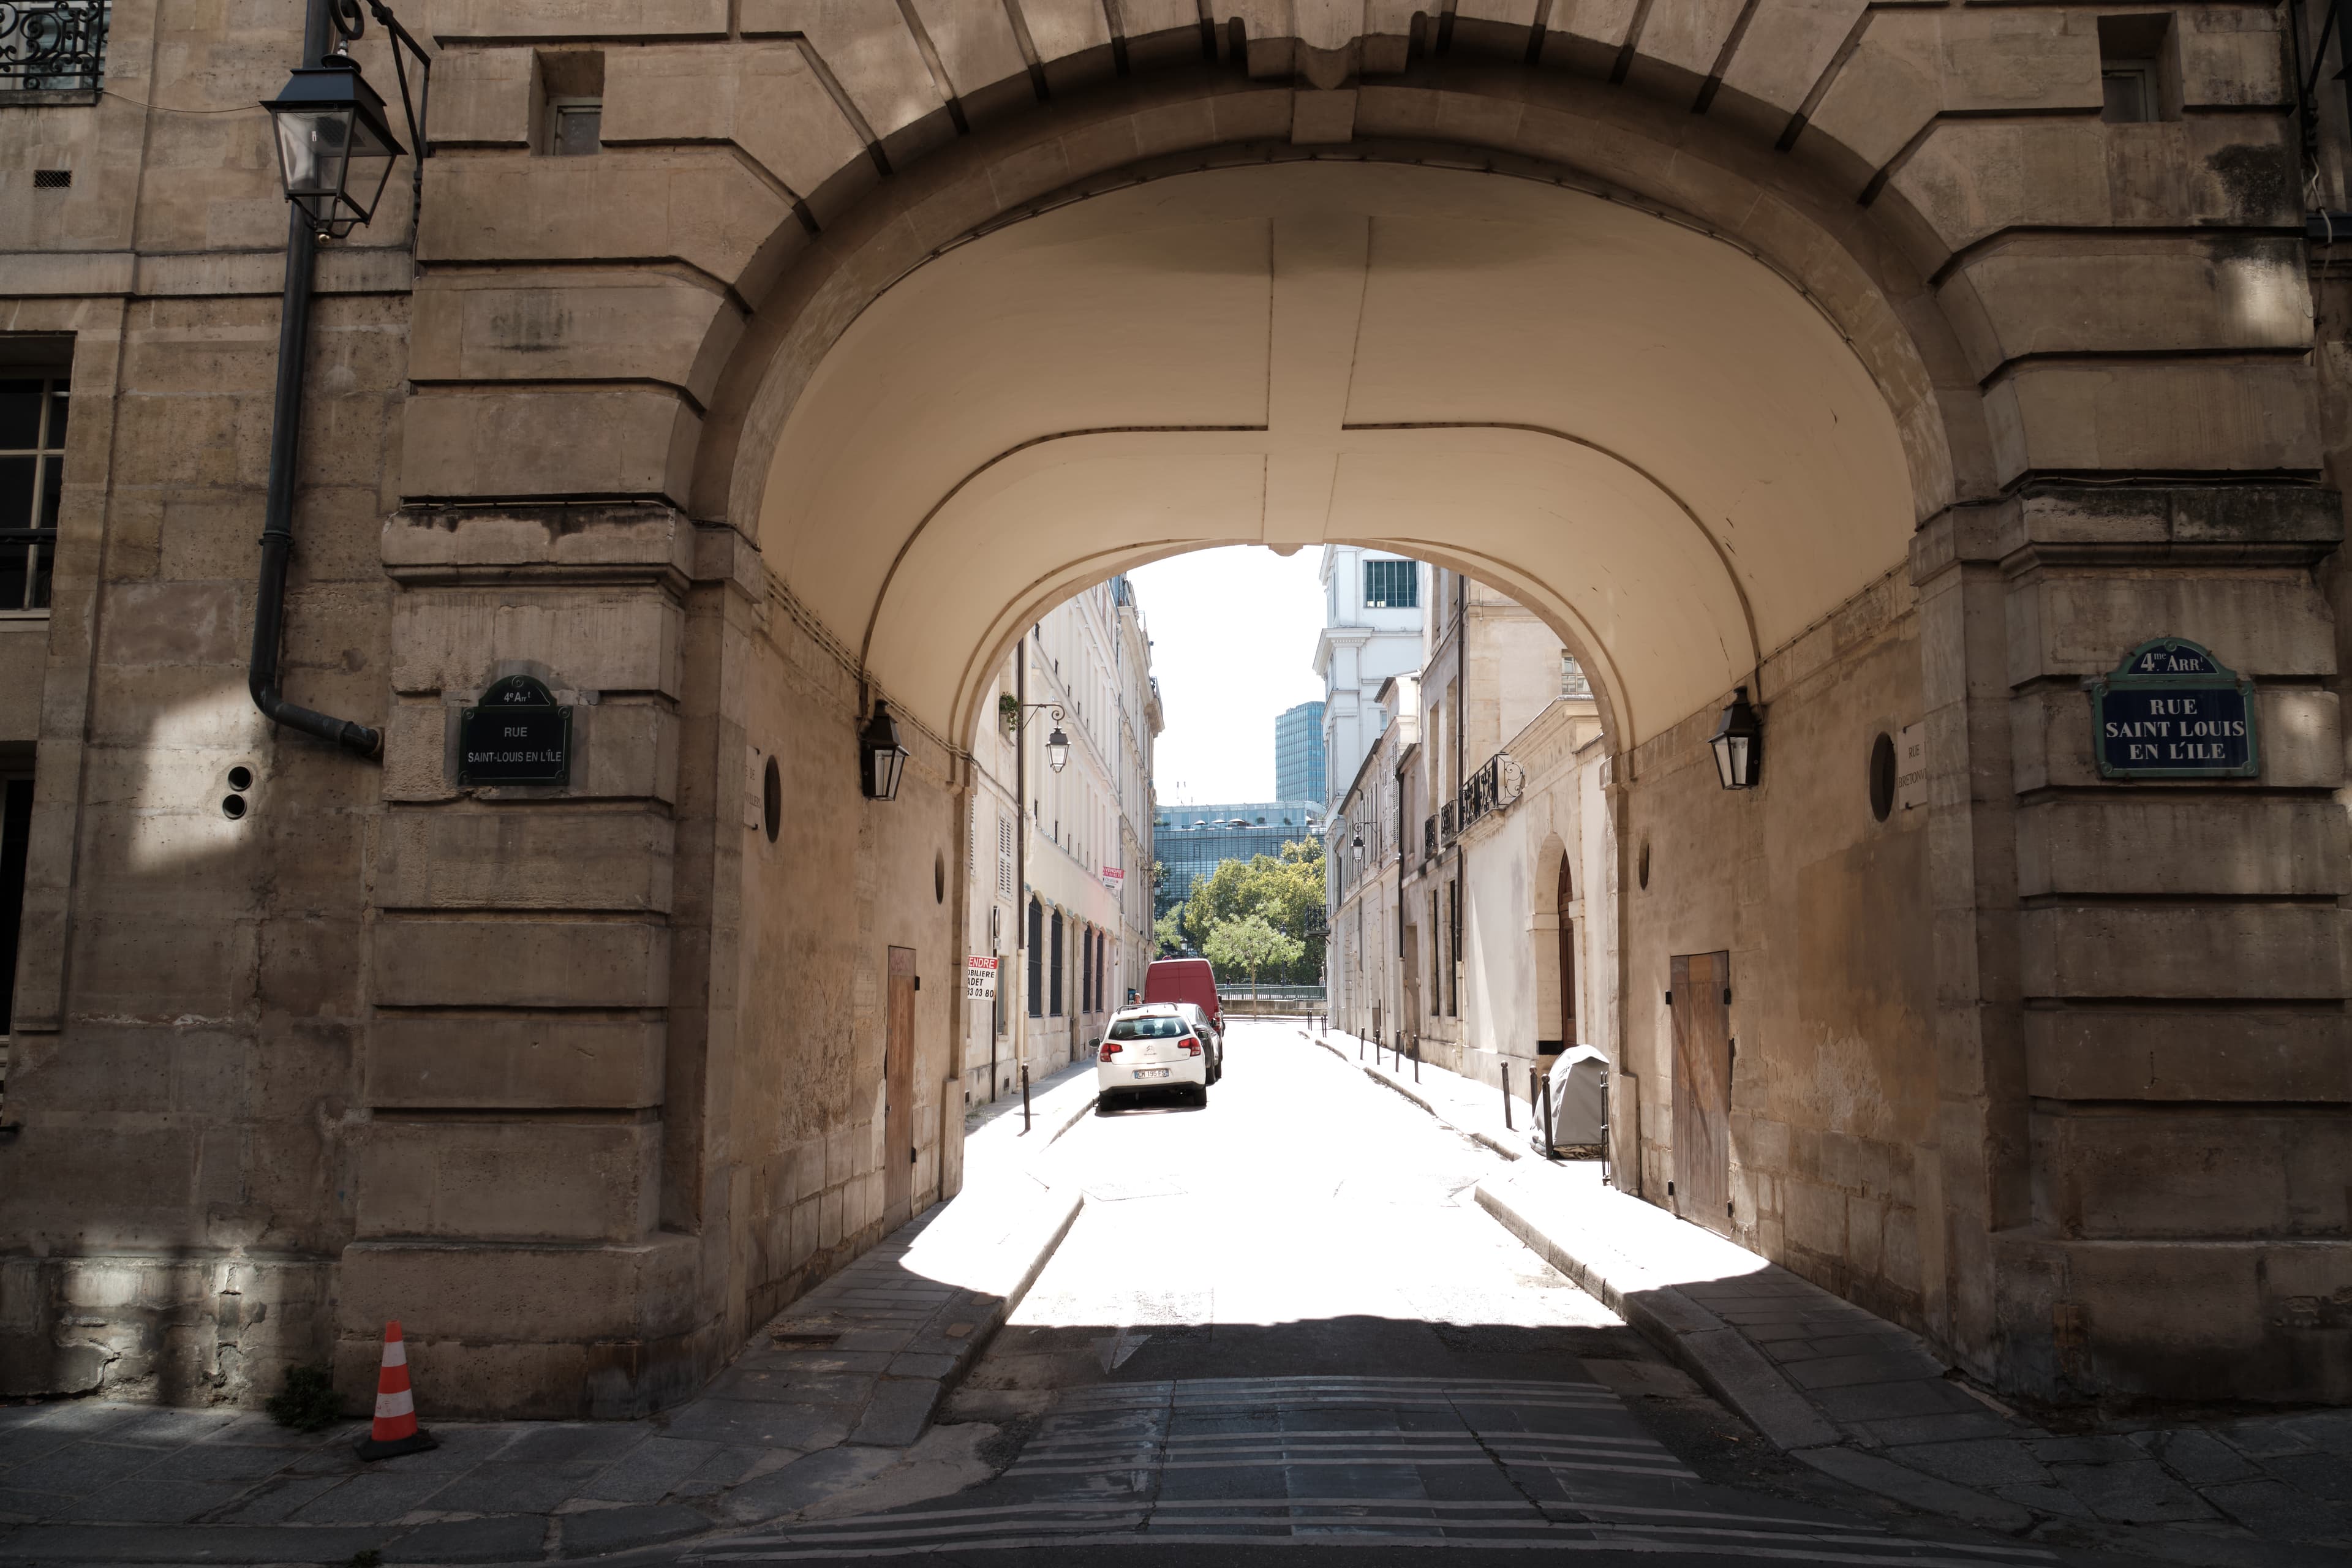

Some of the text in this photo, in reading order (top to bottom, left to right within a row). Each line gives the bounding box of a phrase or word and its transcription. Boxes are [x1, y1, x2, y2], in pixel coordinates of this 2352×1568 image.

[2149, 698, 2198, 715] RUE
[504, 726, 527, 737] RUE
[2105, 720, 2245, 737] SAINT LOUIS
[467, 749, 562, 763] SAINT-LOUIS EN L'ÎLE
[1909, 744, 1920, 759] RUE
[2129, 741, 2225, 760] EN L'ILE
[975, 988, 982, 997] 03
[985, 989, 994, 998] 80
